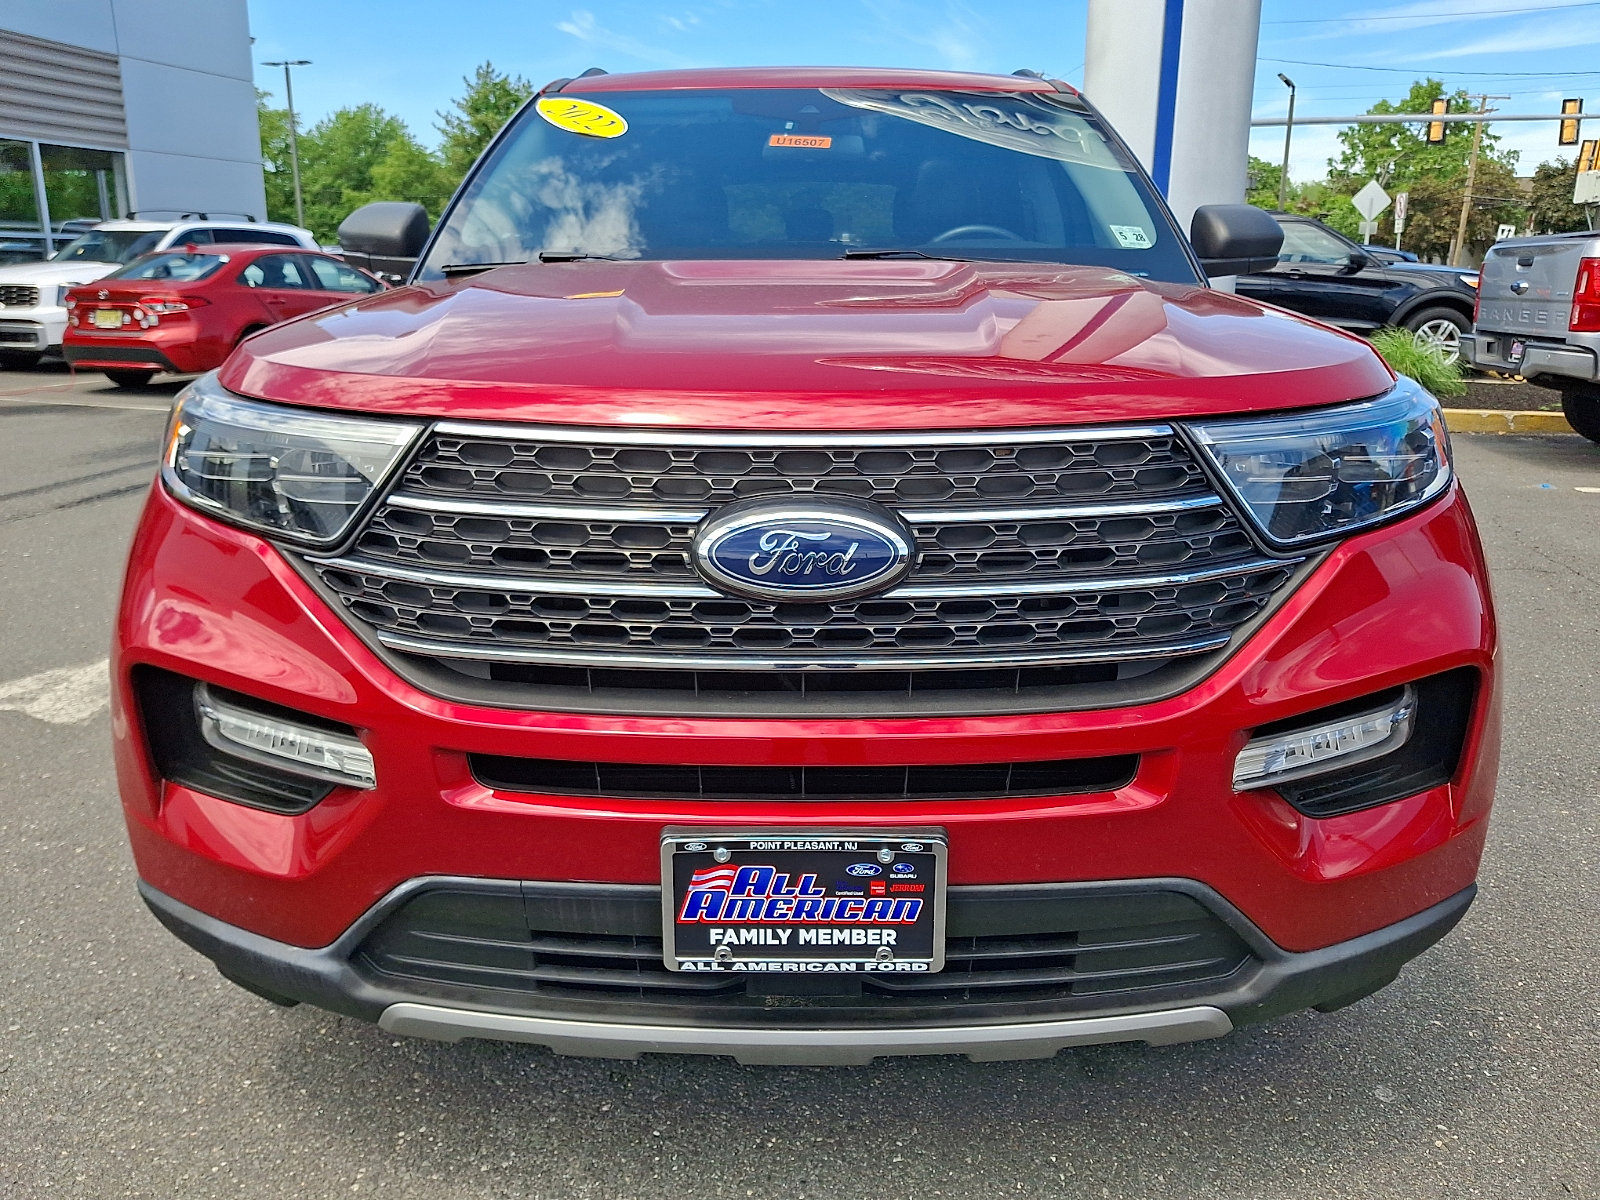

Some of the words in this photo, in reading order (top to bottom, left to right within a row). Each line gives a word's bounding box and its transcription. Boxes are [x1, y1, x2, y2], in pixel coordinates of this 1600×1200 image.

[776, 137, 825, 147] U16507
[1119, 231, 1128, 241] 5
[1132, 233, 1146, 242] 28
[1480, 307, 1567, 325] RANGER
[749, 529, 860, 576] Ford
[749, 841, 782, 850] POINT
[784, 841, 842, 851] PLEASANT,
[845, 842, 858, 850] NJ
[709, 928, 793, 945] FAMILY
[798, 928, 898, 946] MEMBER
[680, 962, 725, 971] ALL
[731, 962, 857, 972] AMERICAN
[864, 962, 928, 972] FORD
